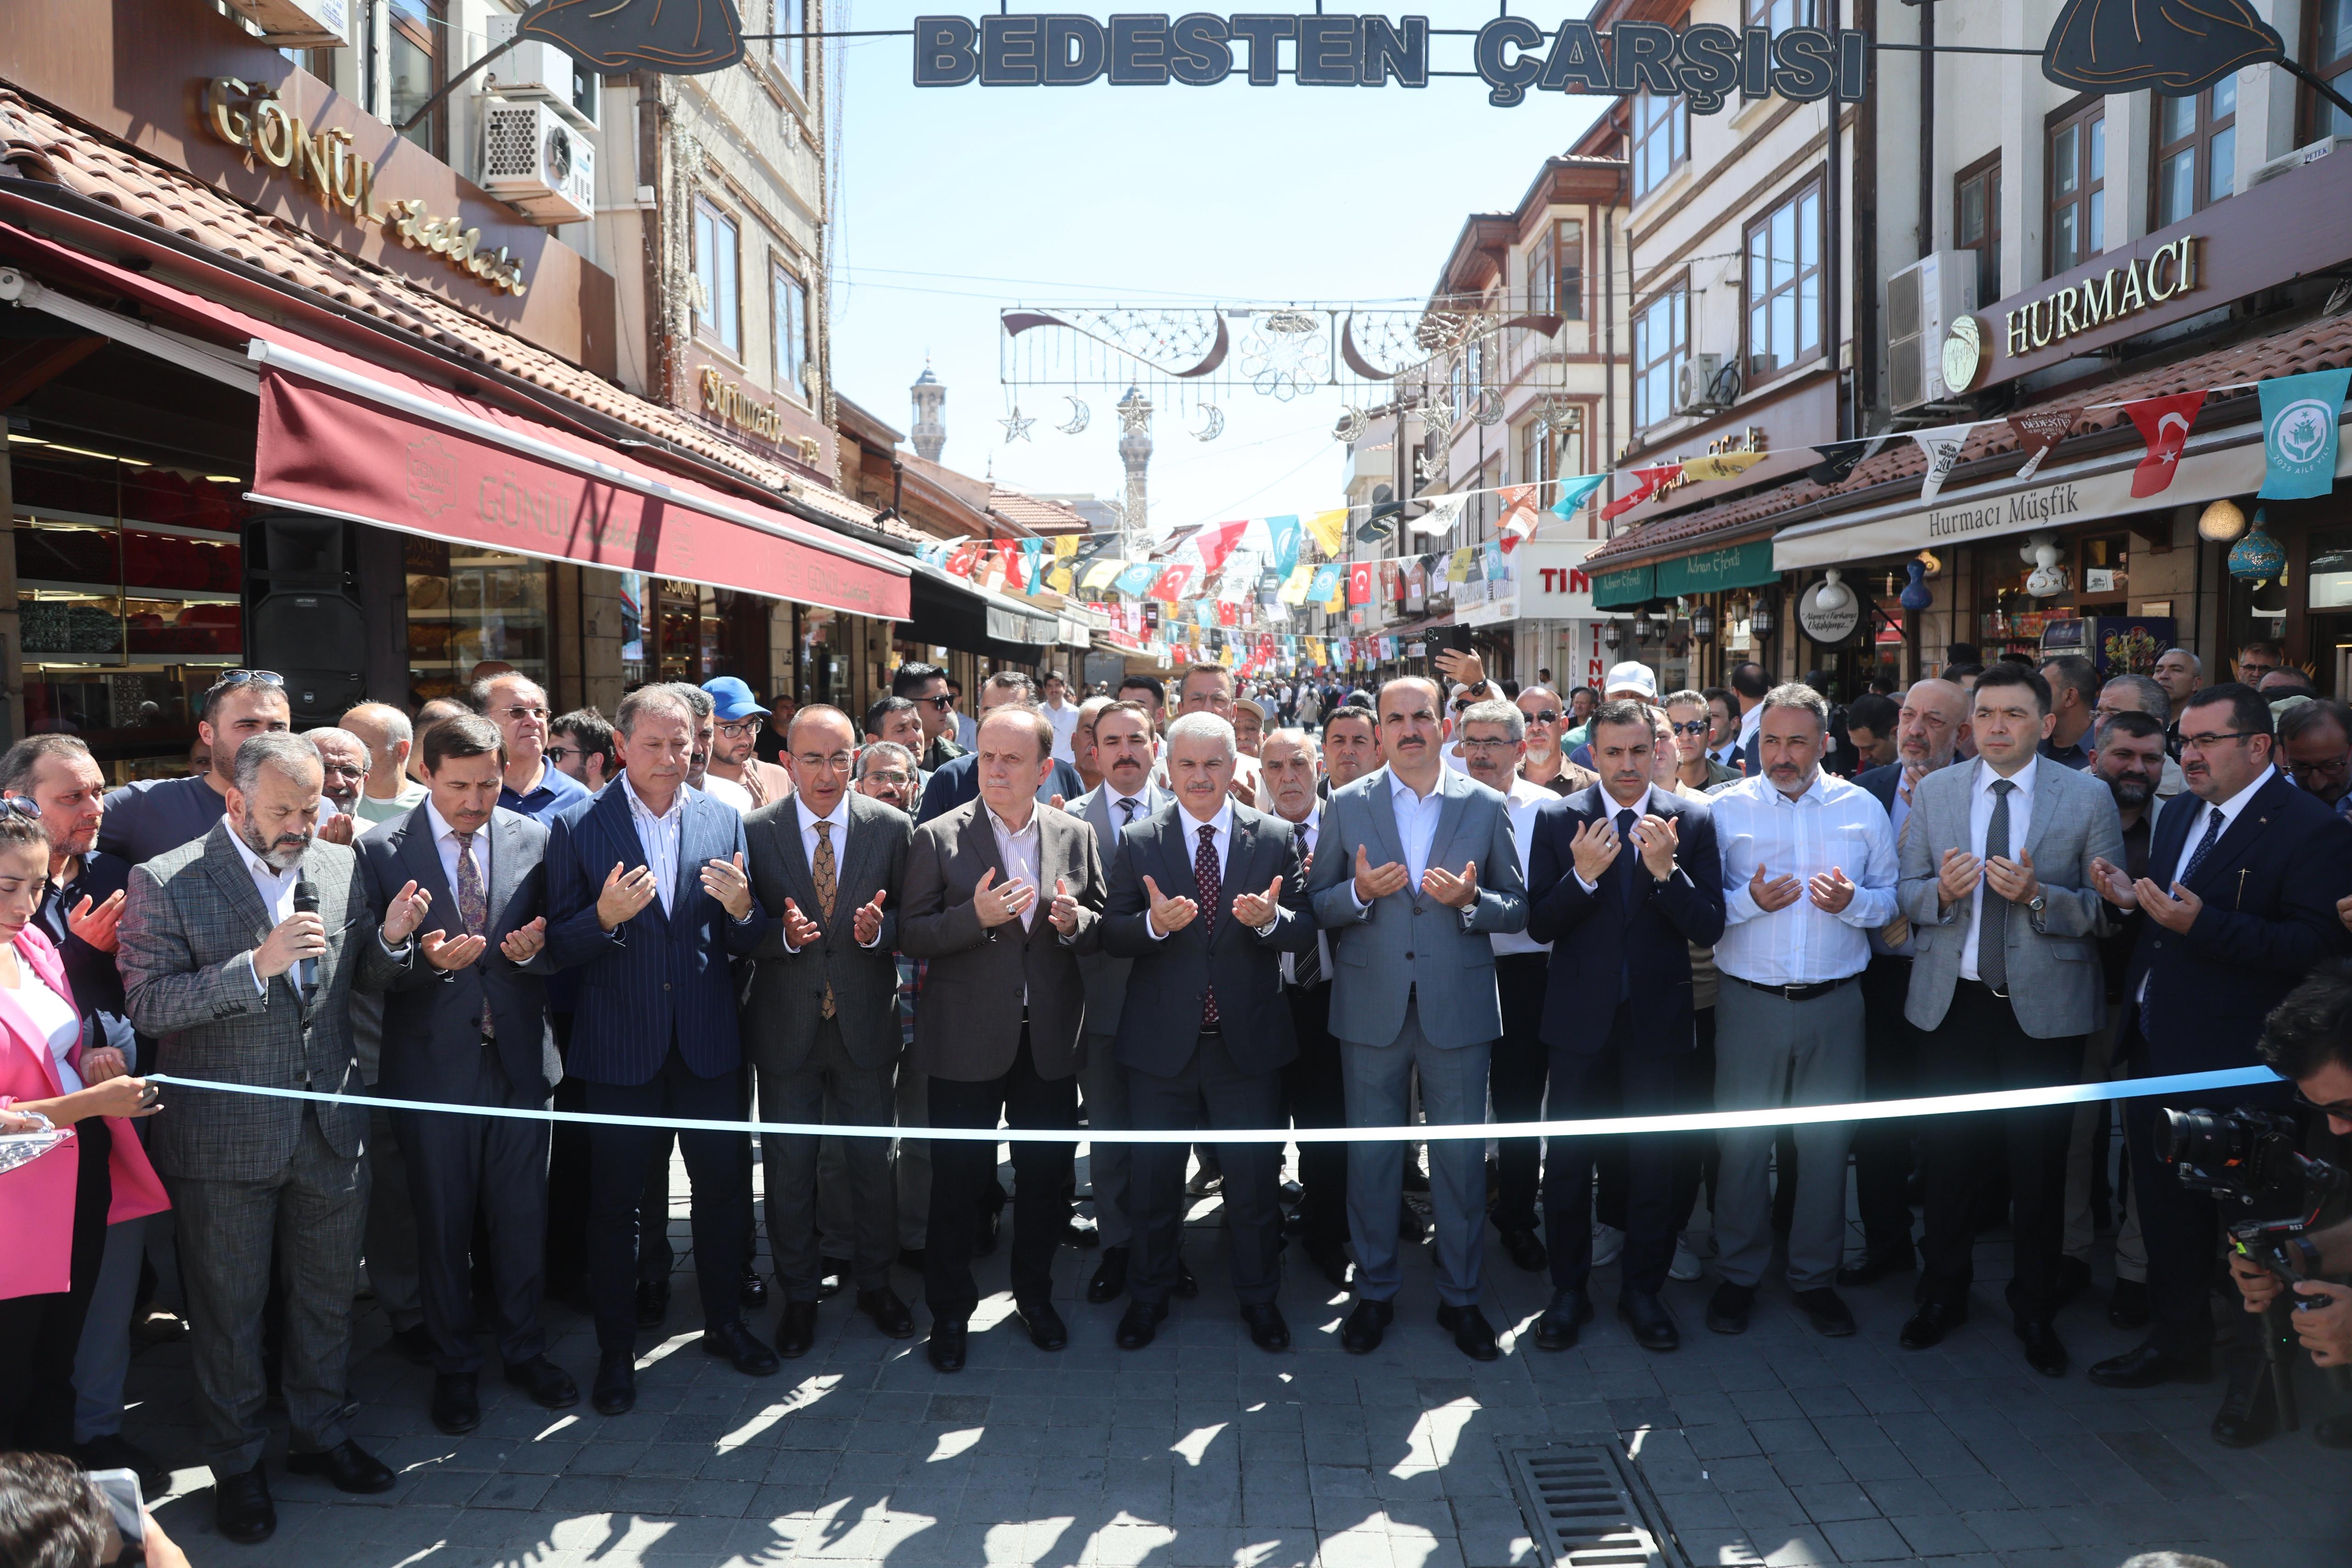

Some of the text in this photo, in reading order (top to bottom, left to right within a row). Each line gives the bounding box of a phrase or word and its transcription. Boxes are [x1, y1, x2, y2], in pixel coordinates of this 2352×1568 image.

[914, 13, 1868, 116] BEDESTEN ÇARŞISI
[208, 75, 386, 225] GÖNÜL
[2305, 146, 2328, 162] PETEK
[2006, 234, 2198, 359] HURMACI
[2273, 447, 2330, 474] 2025 AİLE YILI
[478, 469, 576, 540] GÖNÜL
[1929, 483, 2079, 537] Hurmacı Müşfik
[1604, 569, 1641, 594] Adnan Efendi
[1687, 546, 1740, 581] Adnan Efendi
